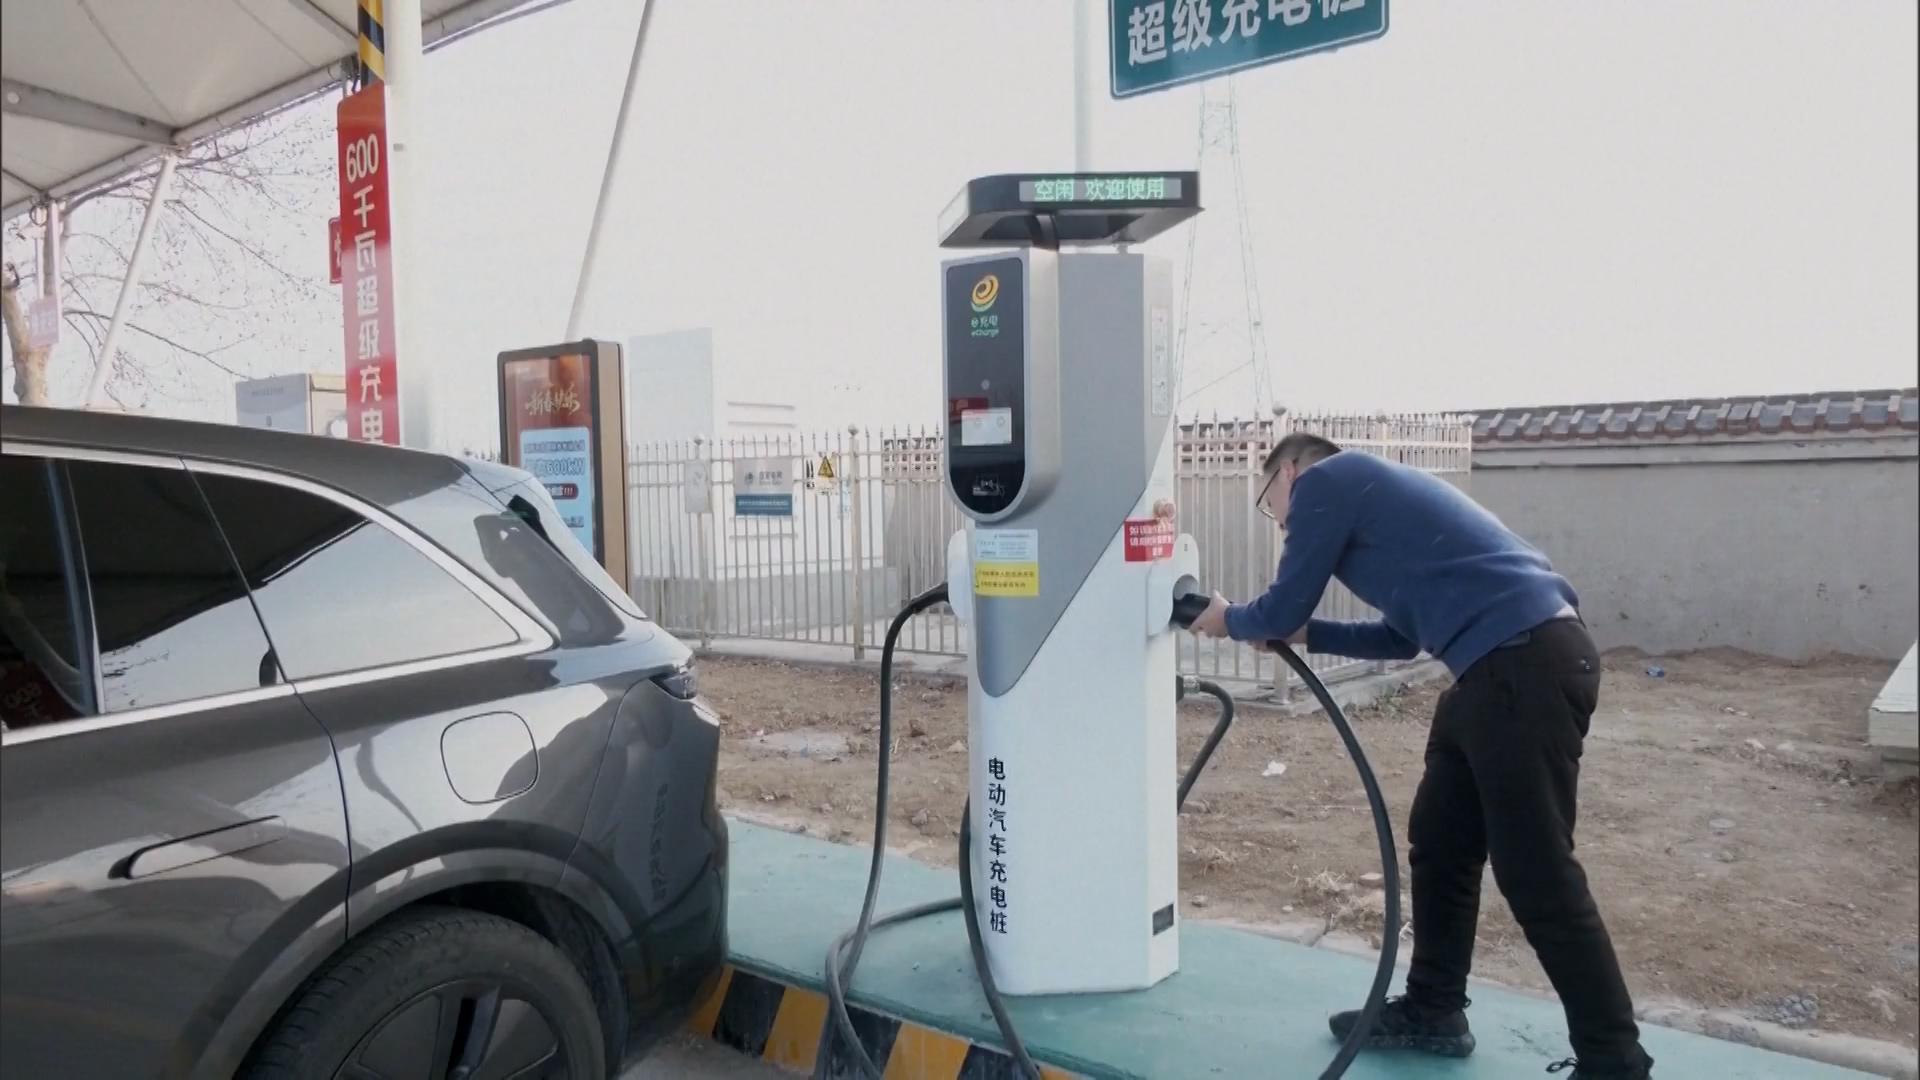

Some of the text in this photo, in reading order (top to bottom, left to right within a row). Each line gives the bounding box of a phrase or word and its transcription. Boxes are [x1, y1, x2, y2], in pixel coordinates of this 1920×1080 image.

[1127, 0, 1366, 66] 超级充电
[1034, 177, 1165, 201] 空闲 欢迎使用
[345, 133, 384, 443] 600千瓦超级充电
[988, 757, 1007, 934] 电动汽车充电桩
